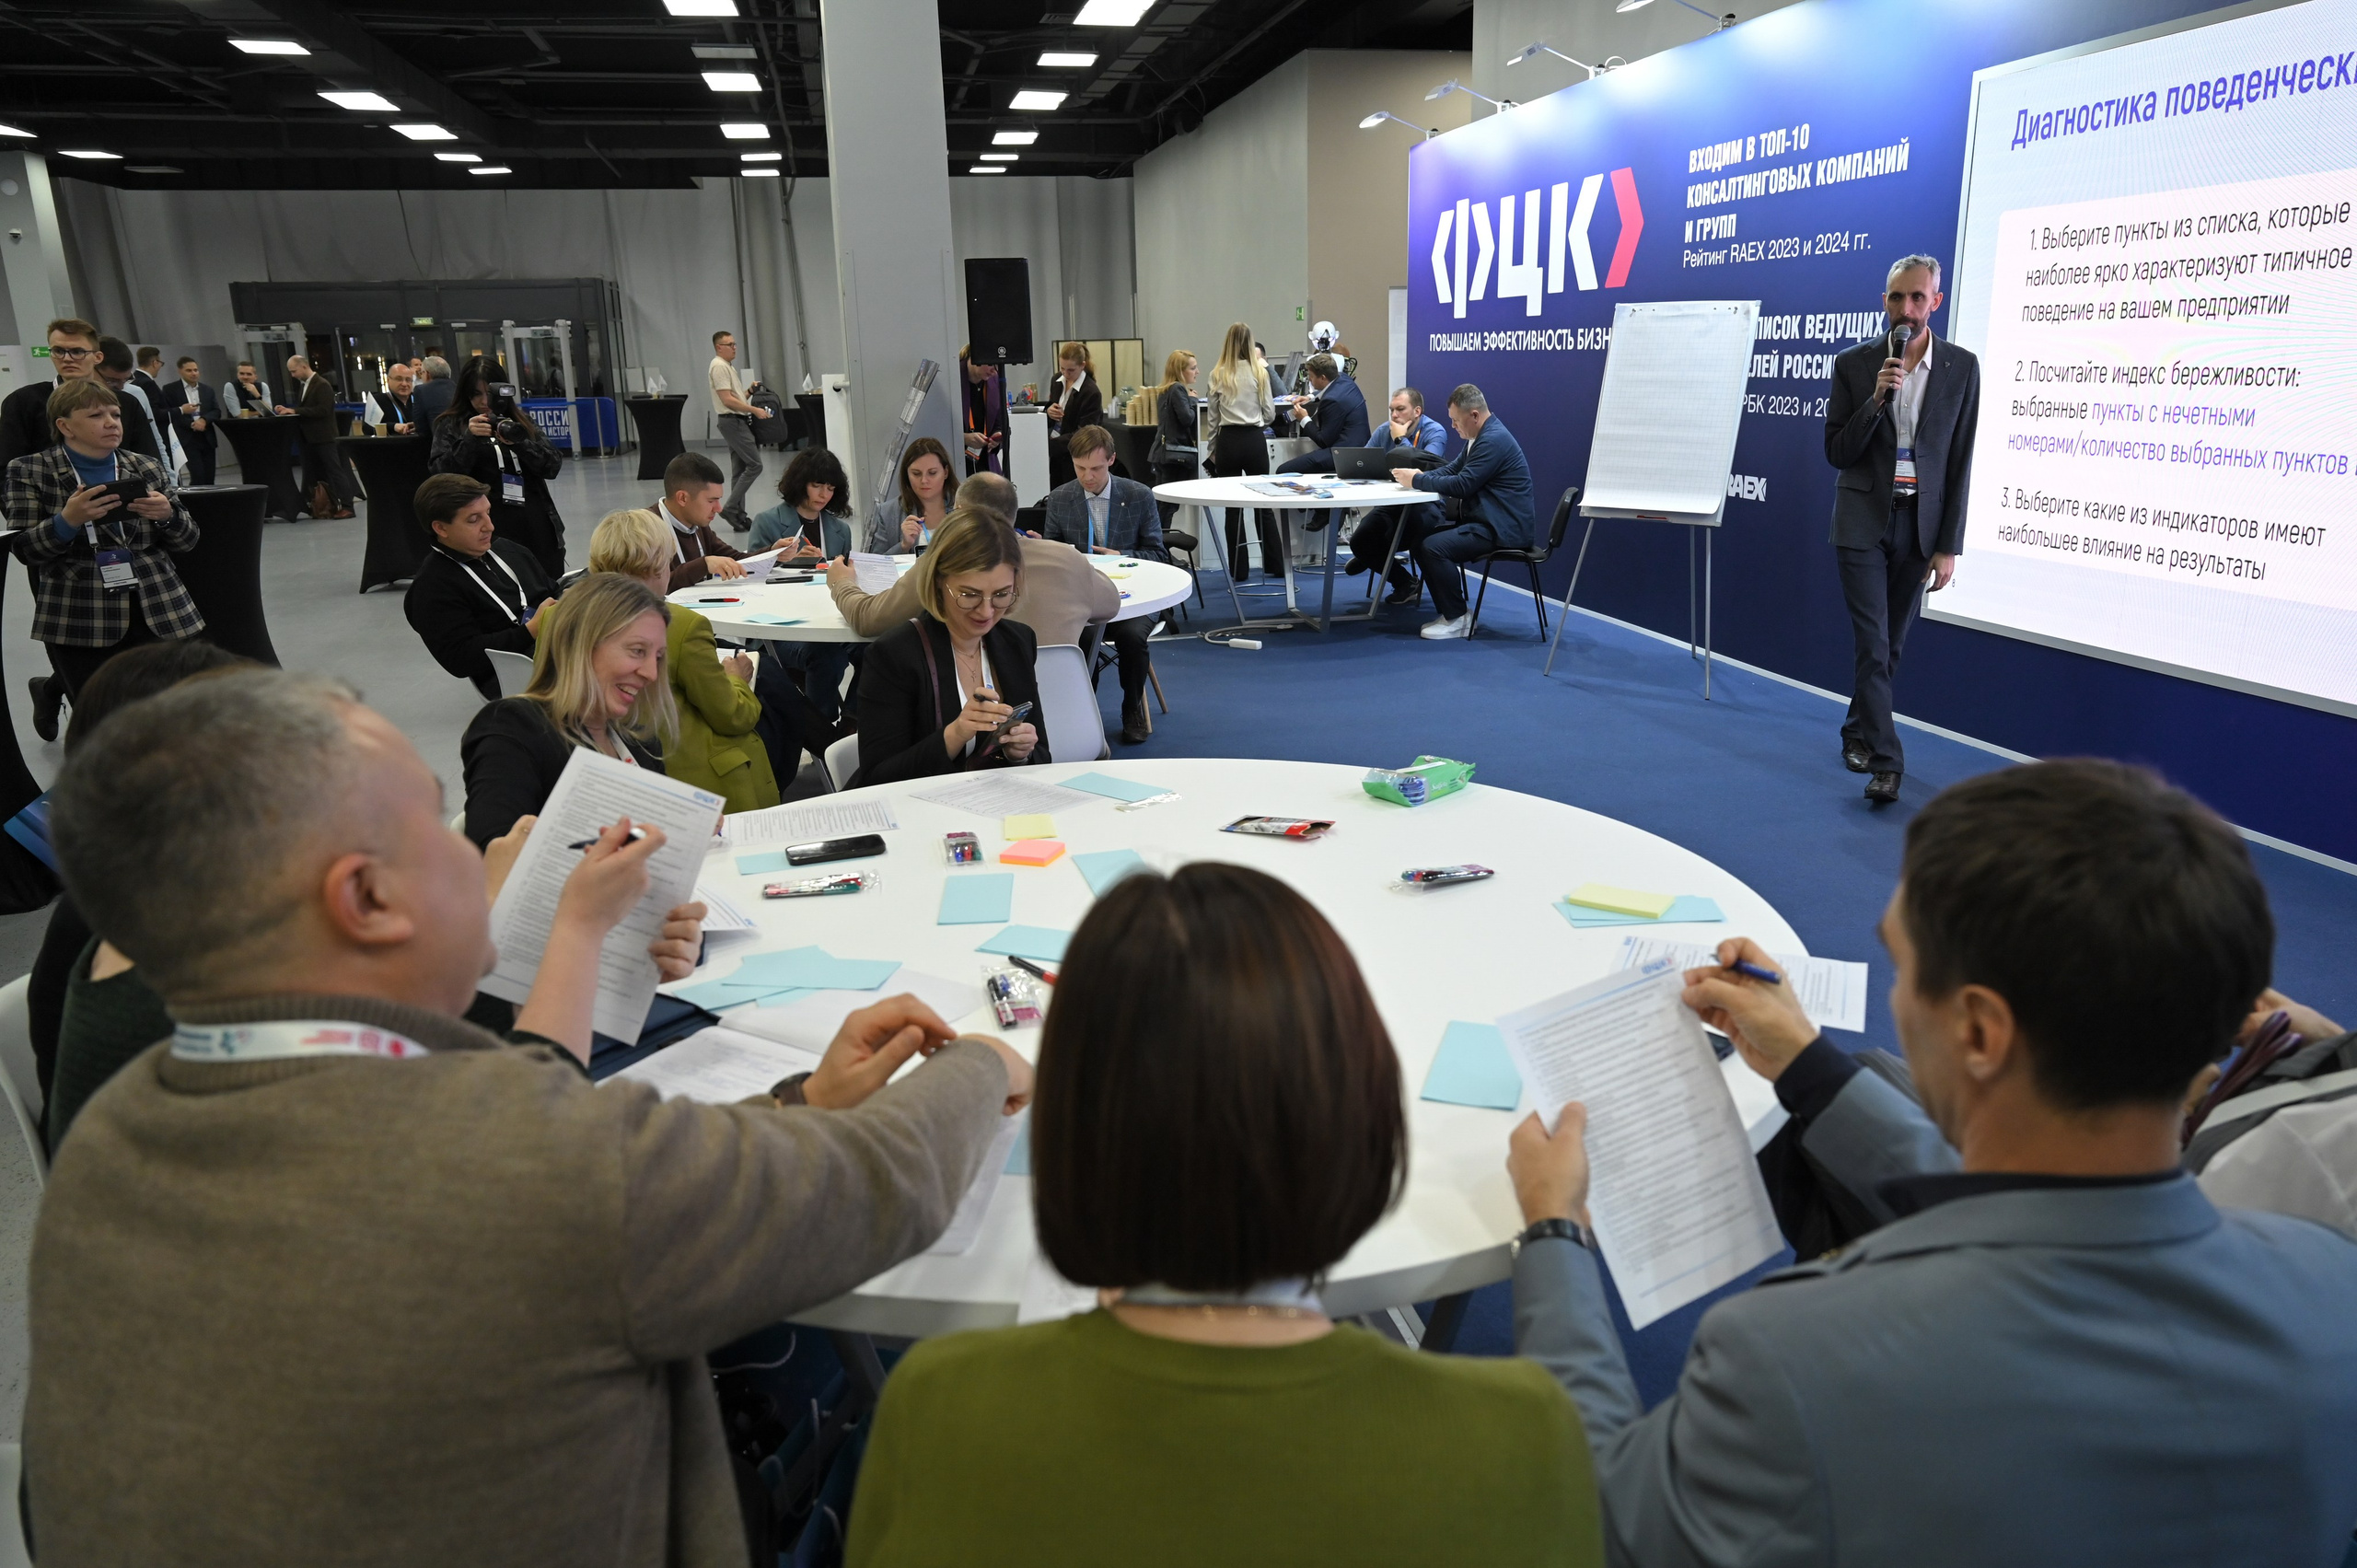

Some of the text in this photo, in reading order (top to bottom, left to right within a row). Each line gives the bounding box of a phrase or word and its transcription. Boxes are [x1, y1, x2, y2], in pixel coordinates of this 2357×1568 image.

[2011, 51, 2357, 151] Диагностика поведенческ
[1689, 122, 1810, 174] ВХОДИМ В ТОП-10
[1686, 136, 1910, 209] КОНСАЛТИНГОВЫХ КОМПАНИЙ
[1684, 213, 1737, 243] И ГРУПП
[2030, 202, 2351, 252] 1. Выберите пункты из списка, которые
[1683, 230, 1872, 268] Рейтинг RAEX 2023 и 2024 гг.
[2026, 247, 2352, 288] наиболее ярко характеризуют типичное
[1805, 310, 1886, 343] ВЕДУЩИХ
[2022, 294, 2290, 325] поведение на вашем предприятии
[1429, 331, 1481, 352] ПОВЫШАЕМ
[1483, 328, 1574, 351] ЭФФЕКТИВНОСТЬ
[1782, 354, 1838, 379] РОССИ
[2014, 360, 2301, 390] 2. Посчитайте индекс бережливости:
[1768, 395, 1799, 415] 2023
[1803, 401, 1811, 417] и
[2012, 395, 2256, 427] выбранные пункты с нечетными
[548, 426, 571, 436] ИСТОР
[2008, 429, 2165, 461] номерами/количество
[2170, 439, 2268, 470] выбранных
[2272, 450, 2348, 477] пунктов
[2001, 487, 2327, 547] 3. Выберите какие из индикаторов имеют
[1998, 523, 2266, 580] наибольшее влияние на результаты
